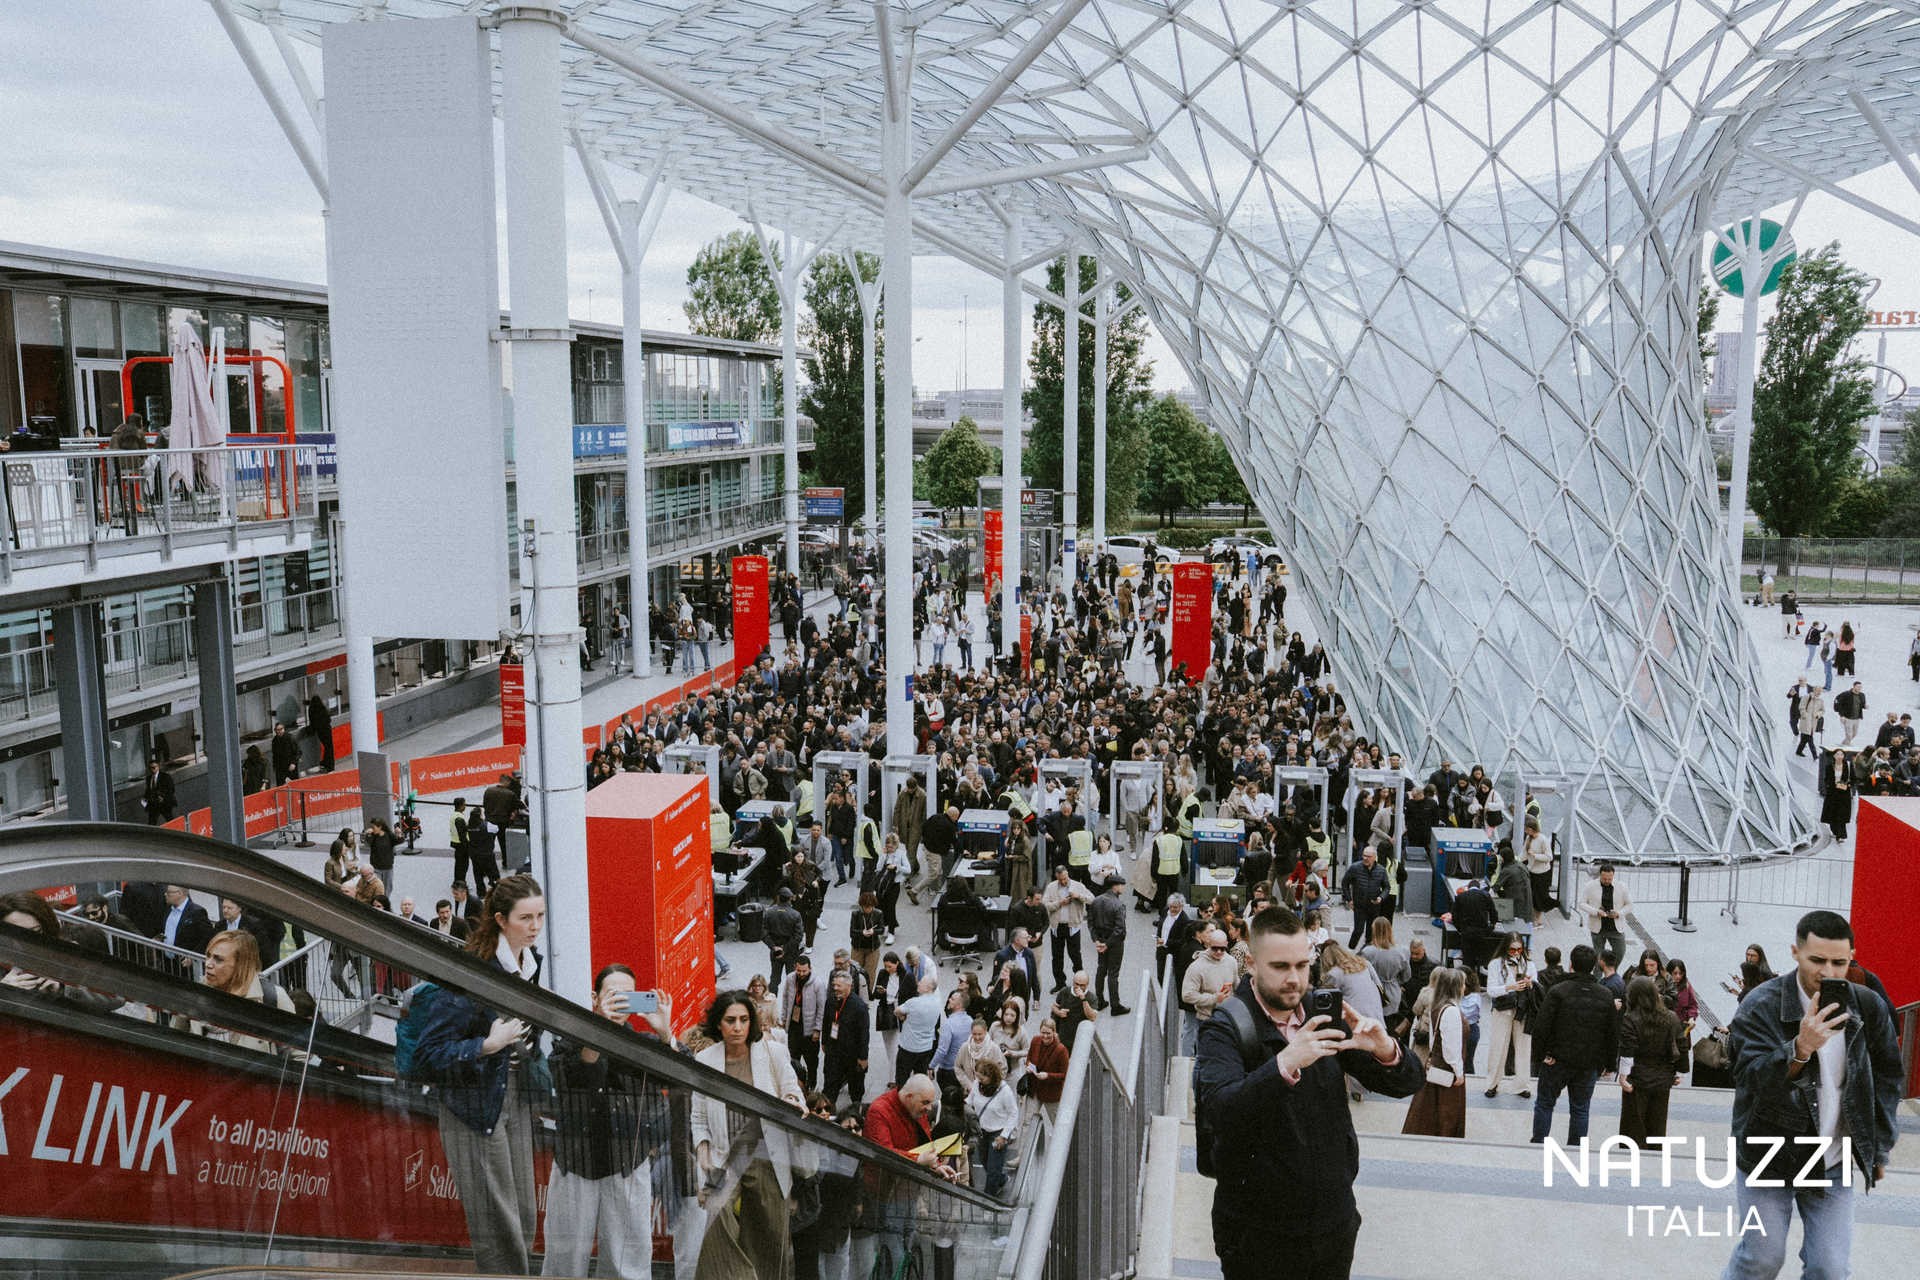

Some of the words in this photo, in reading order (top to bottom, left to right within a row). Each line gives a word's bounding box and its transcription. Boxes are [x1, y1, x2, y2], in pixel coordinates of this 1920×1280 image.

[1022, 493, 1033, 503] M
[31, 1073, 193, 1175] LINK
[208, 1114, 228, 1142] to
[230, 1119, 254, 1146] all
[198, 1160, 211, 1183] a
[214, 1158, 249, 1186] tutti
[249, 1161, 257, 1188] i
